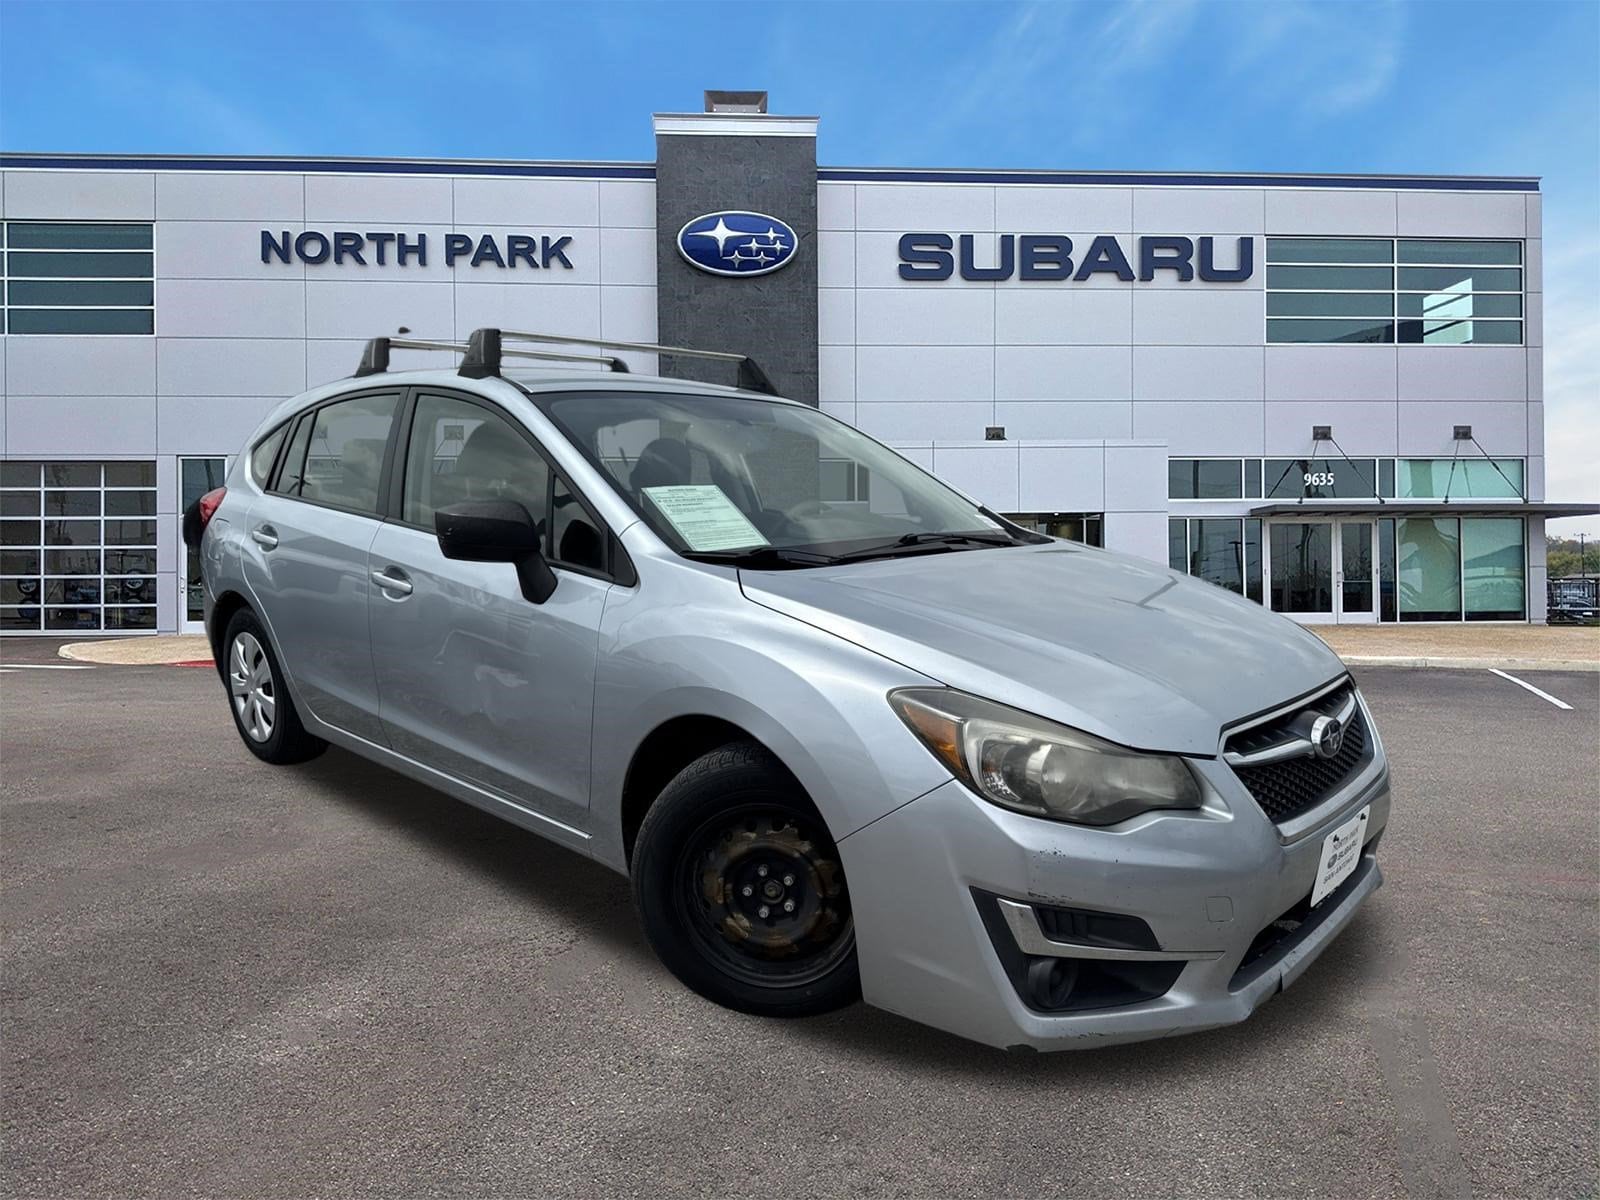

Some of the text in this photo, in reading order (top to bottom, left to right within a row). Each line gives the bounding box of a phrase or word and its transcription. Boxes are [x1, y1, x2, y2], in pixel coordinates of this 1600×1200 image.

[260, 230, 574, 269] NORTH PARK
[898, 233, 1254, 282] SUBARU
[1303, 472, 1335, 486] 9635
